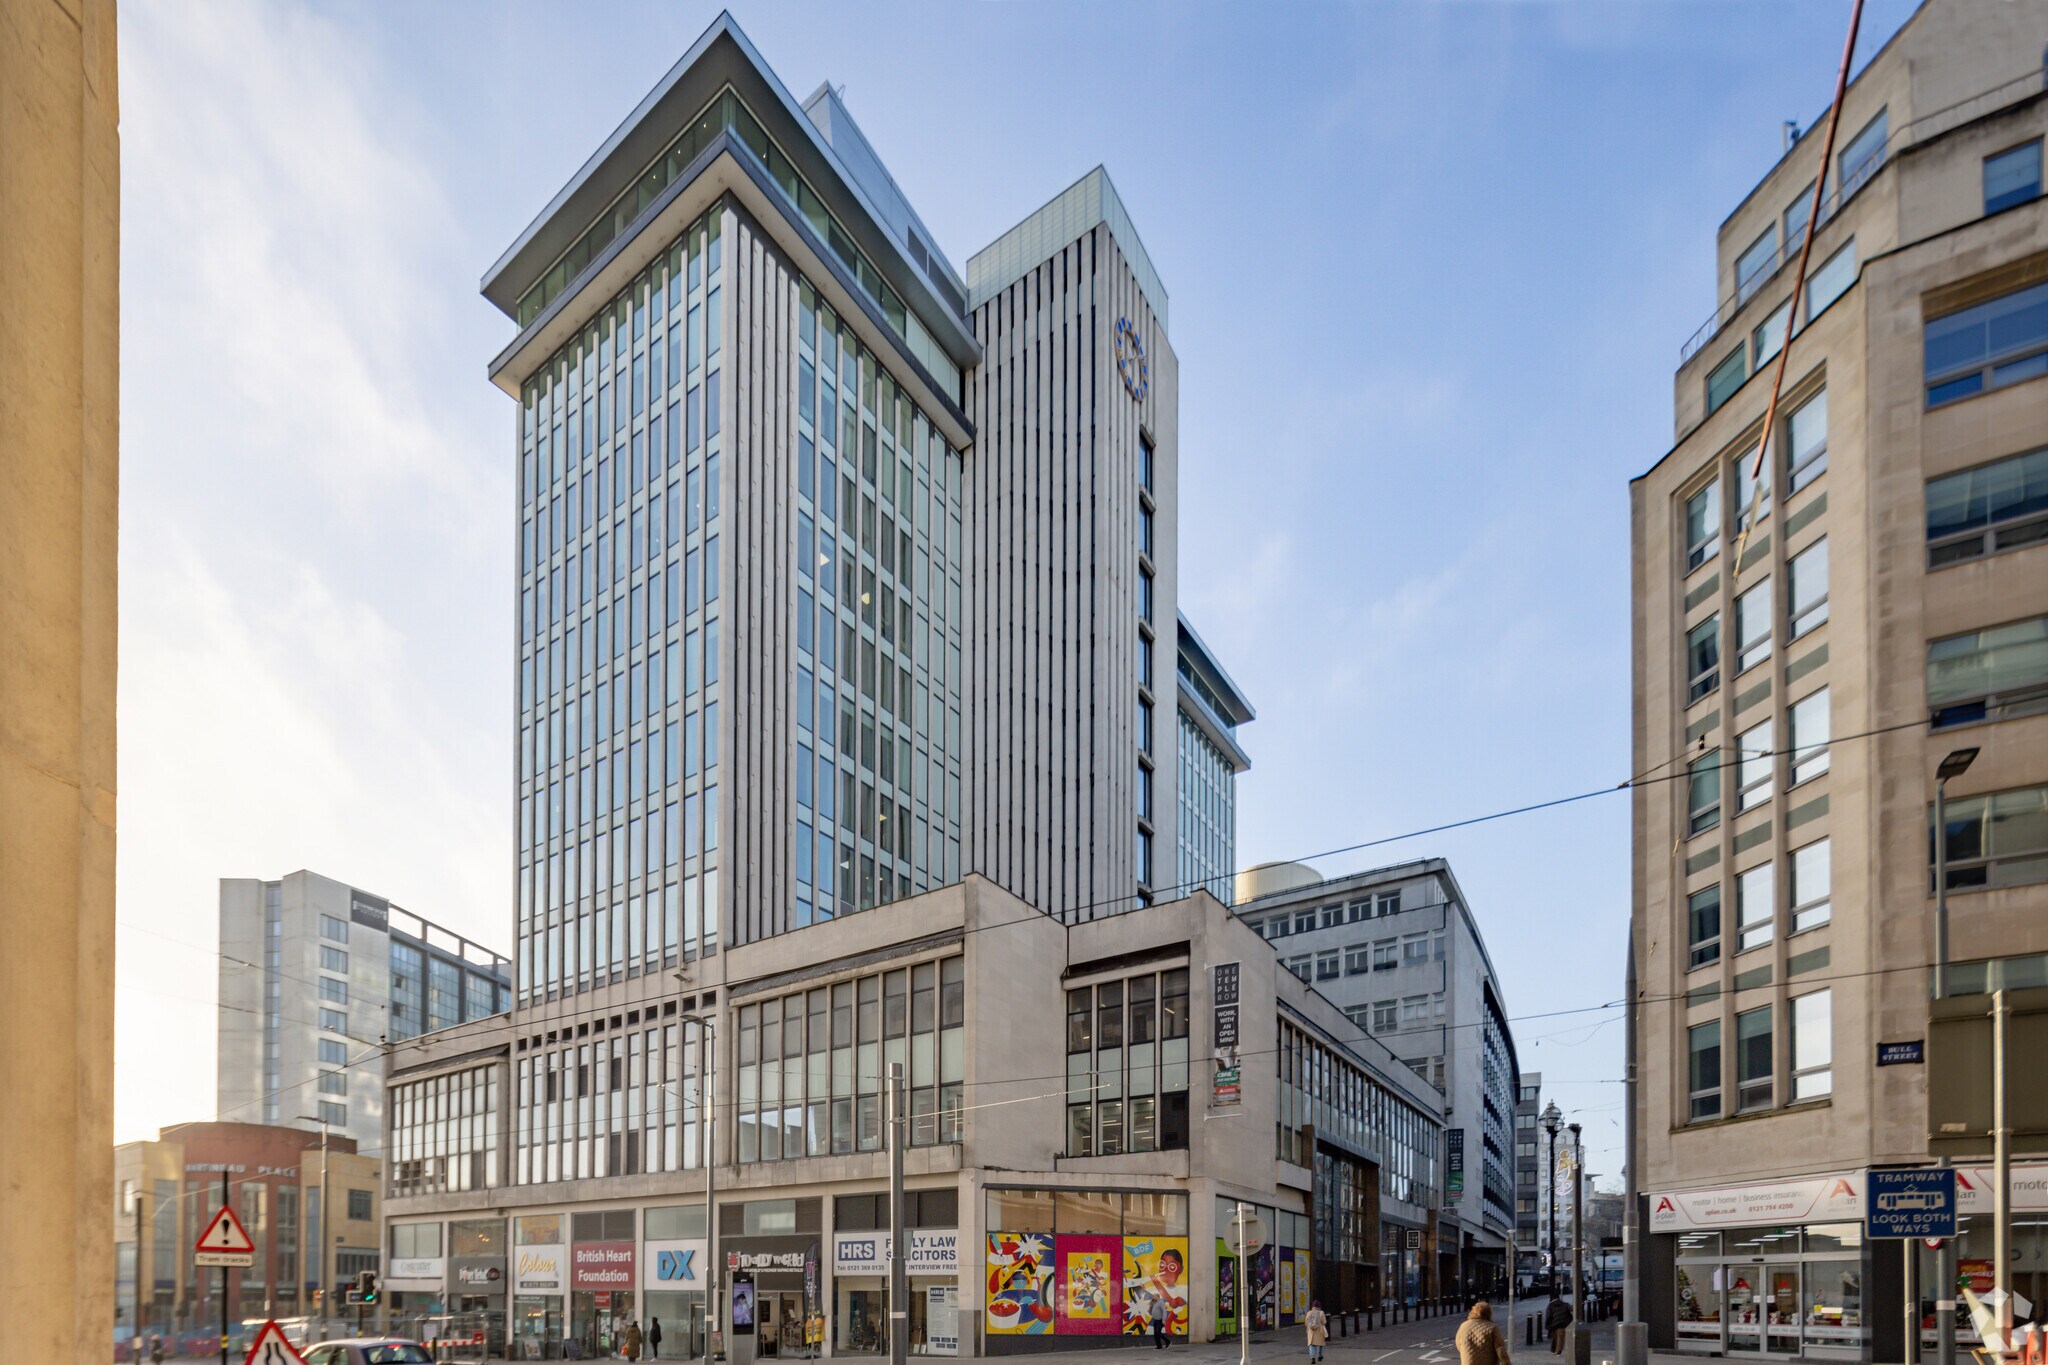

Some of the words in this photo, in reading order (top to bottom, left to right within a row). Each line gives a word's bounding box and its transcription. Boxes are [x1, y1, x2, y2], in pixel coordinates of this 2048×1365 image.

[1888, 1045, 1912, 1053] BULL
[1882, 1052, 1918, 1060] STREET
[258, 1166, 297, 1177] PLACE
[1877, 1172, 1945, 1183] TRAMWAY
[2013, 1180, 2048, 1190] moto
[1693, 1198, 1711, 1207] motor
[1717, 1196, 1737, 1205] home
[1743, 1192, 1772, 1203] business
[1655, 1212, 1676, 1221] a-plan
[1705, 1208, 1737, 1217] aplan.co.uk
[1872, 1214, 1908, 1224] LOOK
[1913, 1213, 1951, 1223] BOTH
[1892, 1224, 1930, 1233] WAYS
[886, 1237, 926, 1249] FLY
[930, 1237, 956, 1247] LAW
[841, 1243, 874, 1259] HRS
[1133, 1245, 1150, 1254] BDF
[577, 1251, 605, 1262] British
[607, 1250, 632, 1262] Heart
[886, 1250, 956, 1261] SCITORS
[518, 1251, 557, 1278] Colour
[657, 1250, 695, 1280] DX
[578, 1269, 629, 1282] Foundation
